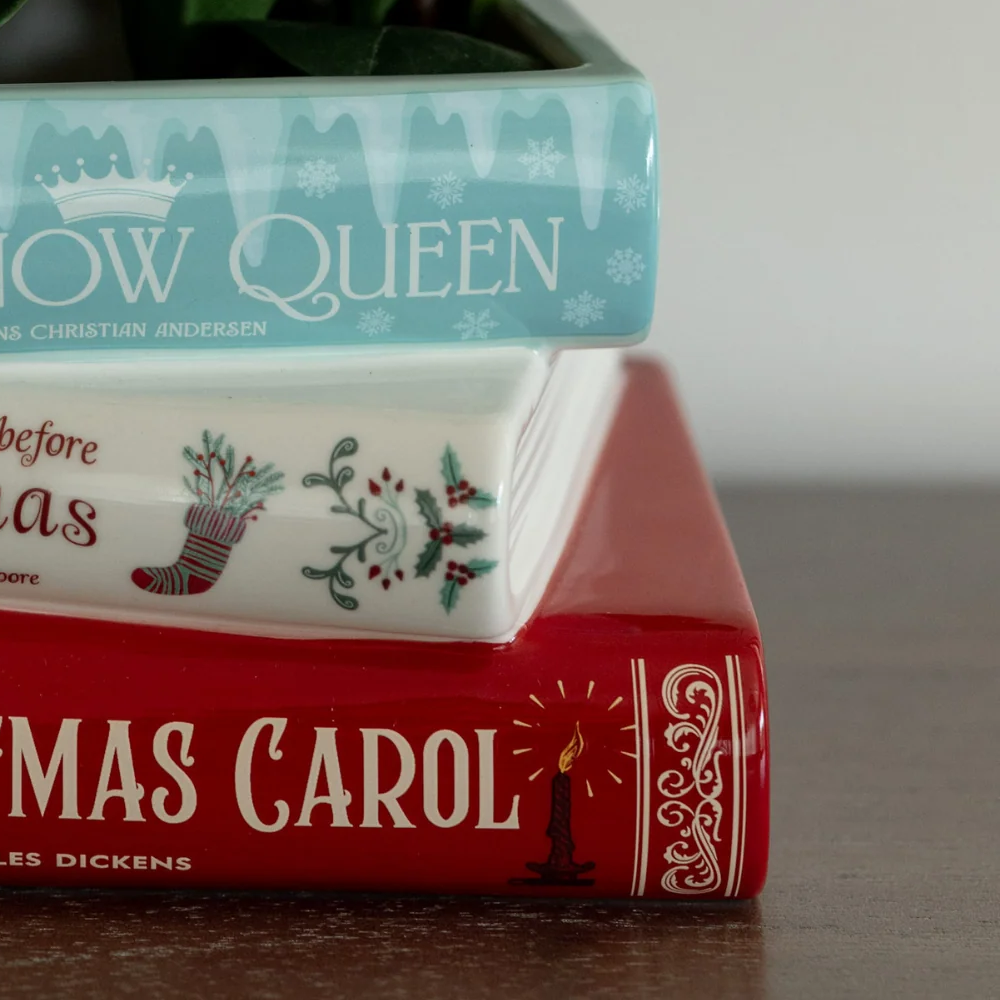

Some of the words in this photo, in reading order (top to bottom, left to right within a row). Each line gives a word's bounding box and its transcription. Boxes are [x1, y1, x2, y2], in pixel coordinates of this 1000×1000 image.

[228, 213, 564, 322] QUEEN
[30, 321, 147, 342] CHRISTIAN
[154, 320, 268, 338] ANDERSEN
[234, 716, 520, 833] CAROL
[55, 852, 192, 871] DICKENS
